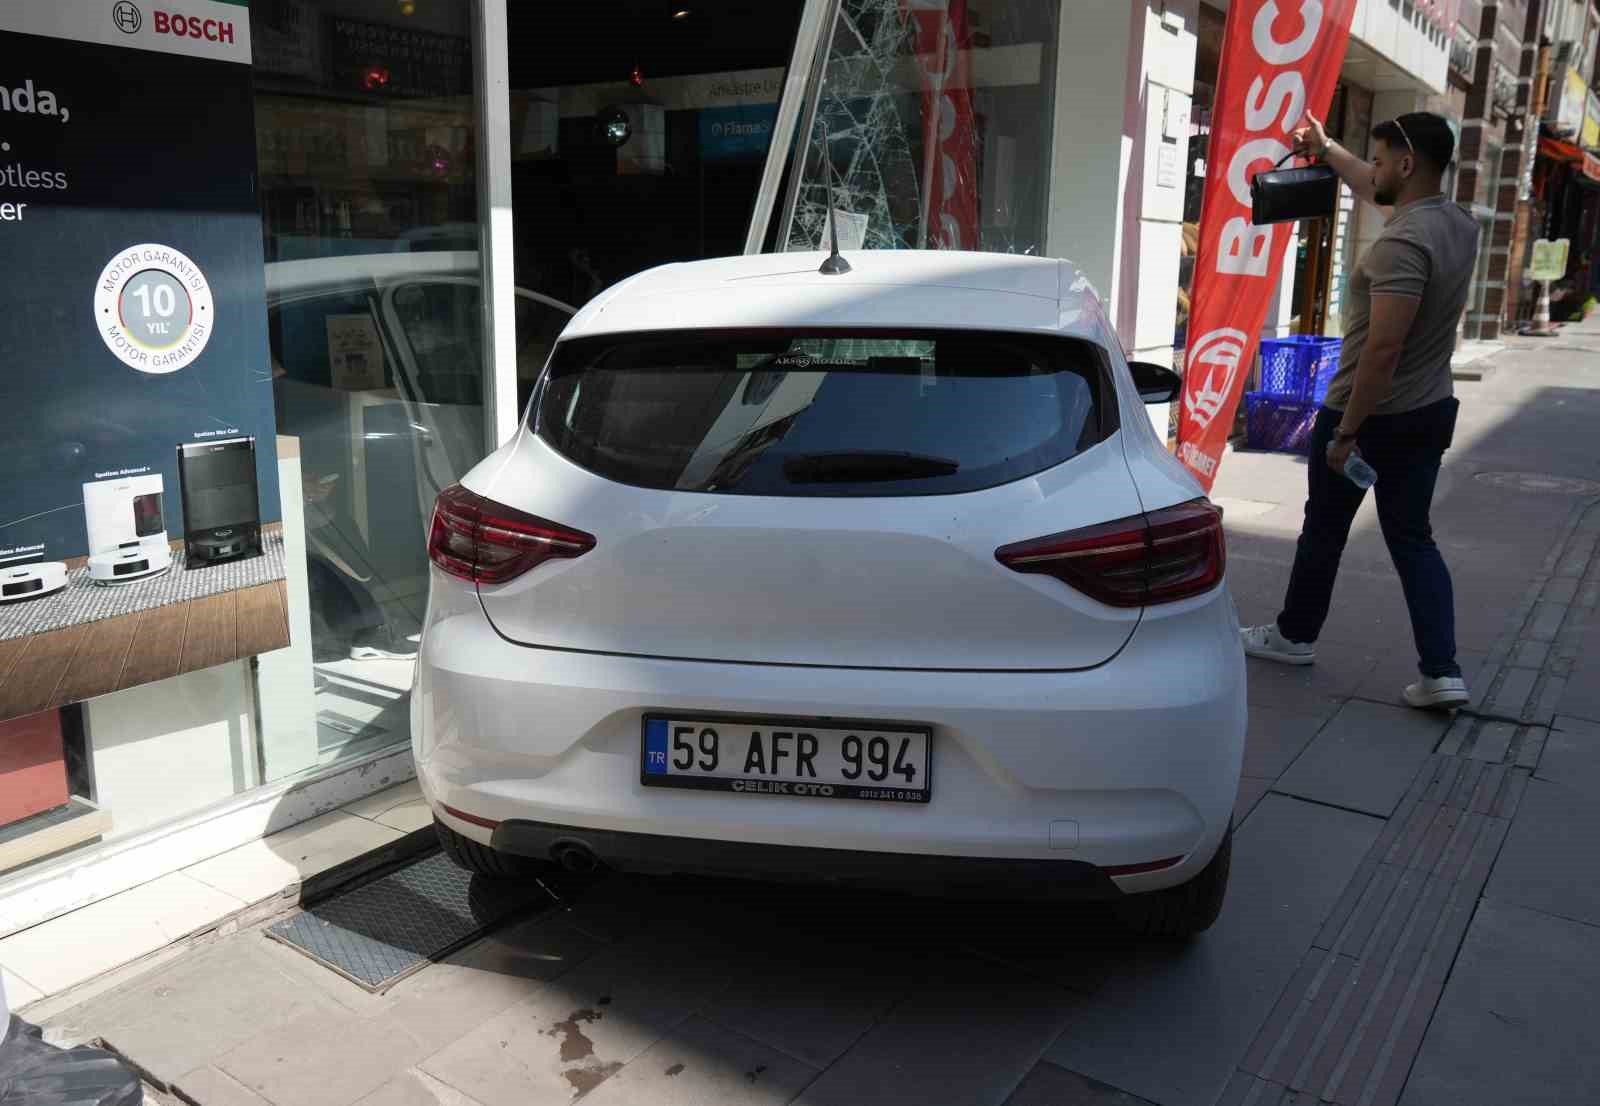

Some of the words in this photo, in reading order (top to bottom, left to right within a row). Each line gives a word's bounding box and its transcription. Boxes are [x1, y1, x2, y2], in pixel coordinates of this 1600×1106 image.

[153, 10, 235, 45] BOSCH
[0, 201, 28, 221] er
[103, 253, 141, 293] MOTOR
[132, 283, 176, 318] 10
[107, 325, 149, 365] MOTOR
[649, 750, 666, 765] TR
[672, 726, 719, 772] 59
[743, 730, 819, 778] AFR
[840, 735, 916, 783] 994
[793, 782, 835, 796] OTO
